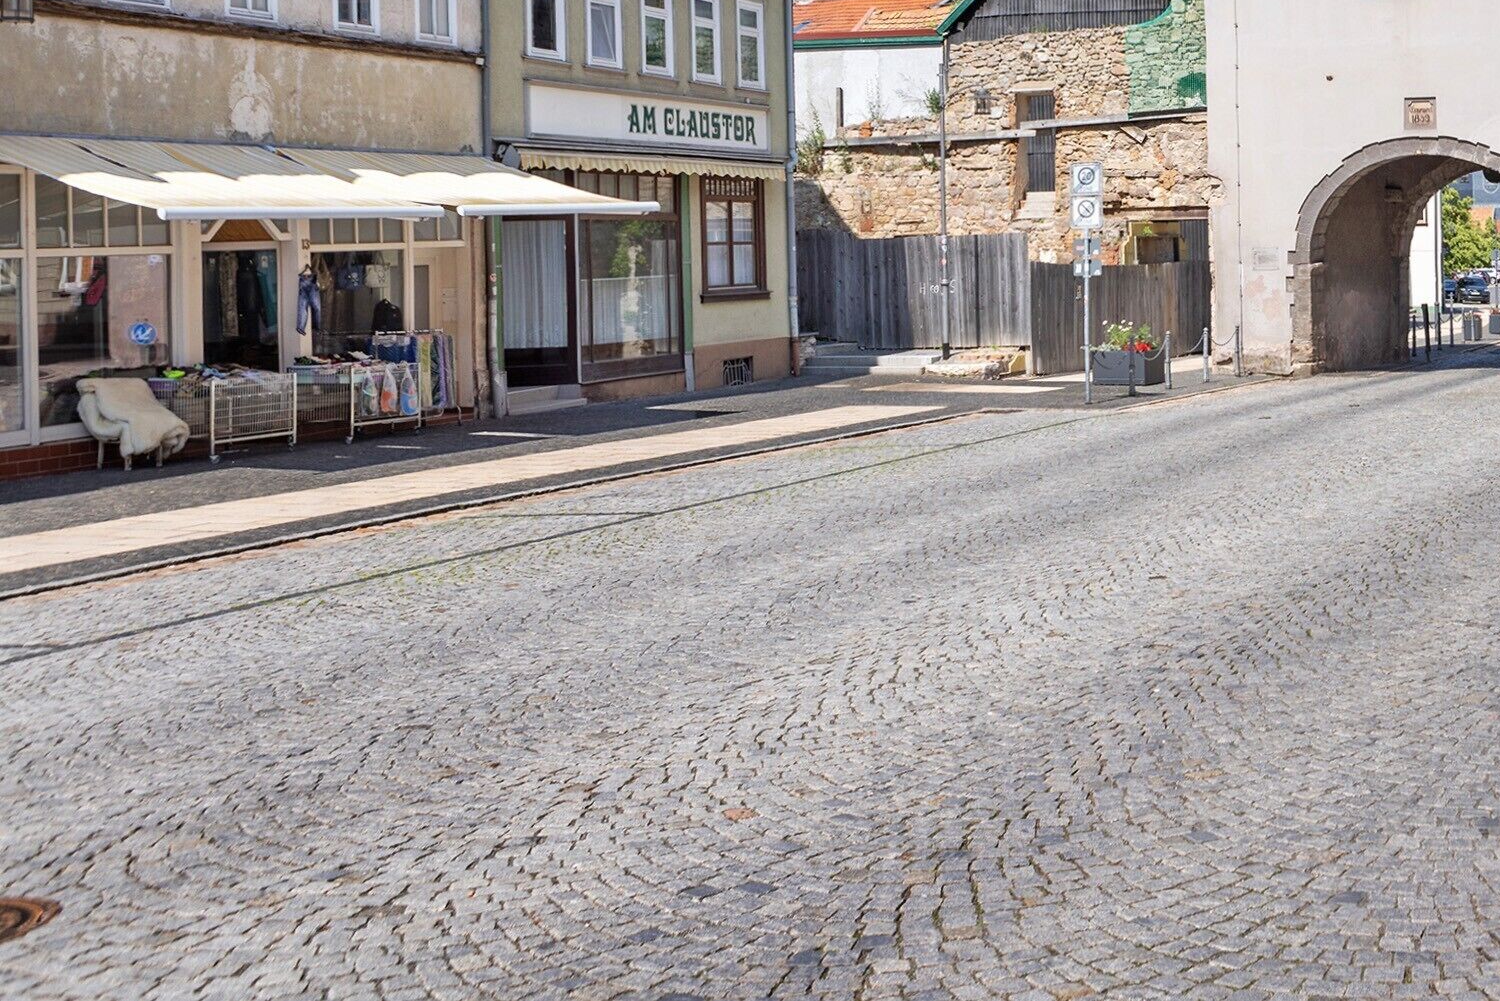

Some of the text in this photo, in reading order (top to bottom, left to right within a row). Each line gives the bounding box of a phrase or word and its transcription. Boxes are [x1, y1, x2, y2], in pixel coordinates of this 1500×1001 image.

[627, 104, 757, 146] AM CLAUSTOR
[1081, 171, 1092, 181] 20
[301, 238, 310, 250] 13
